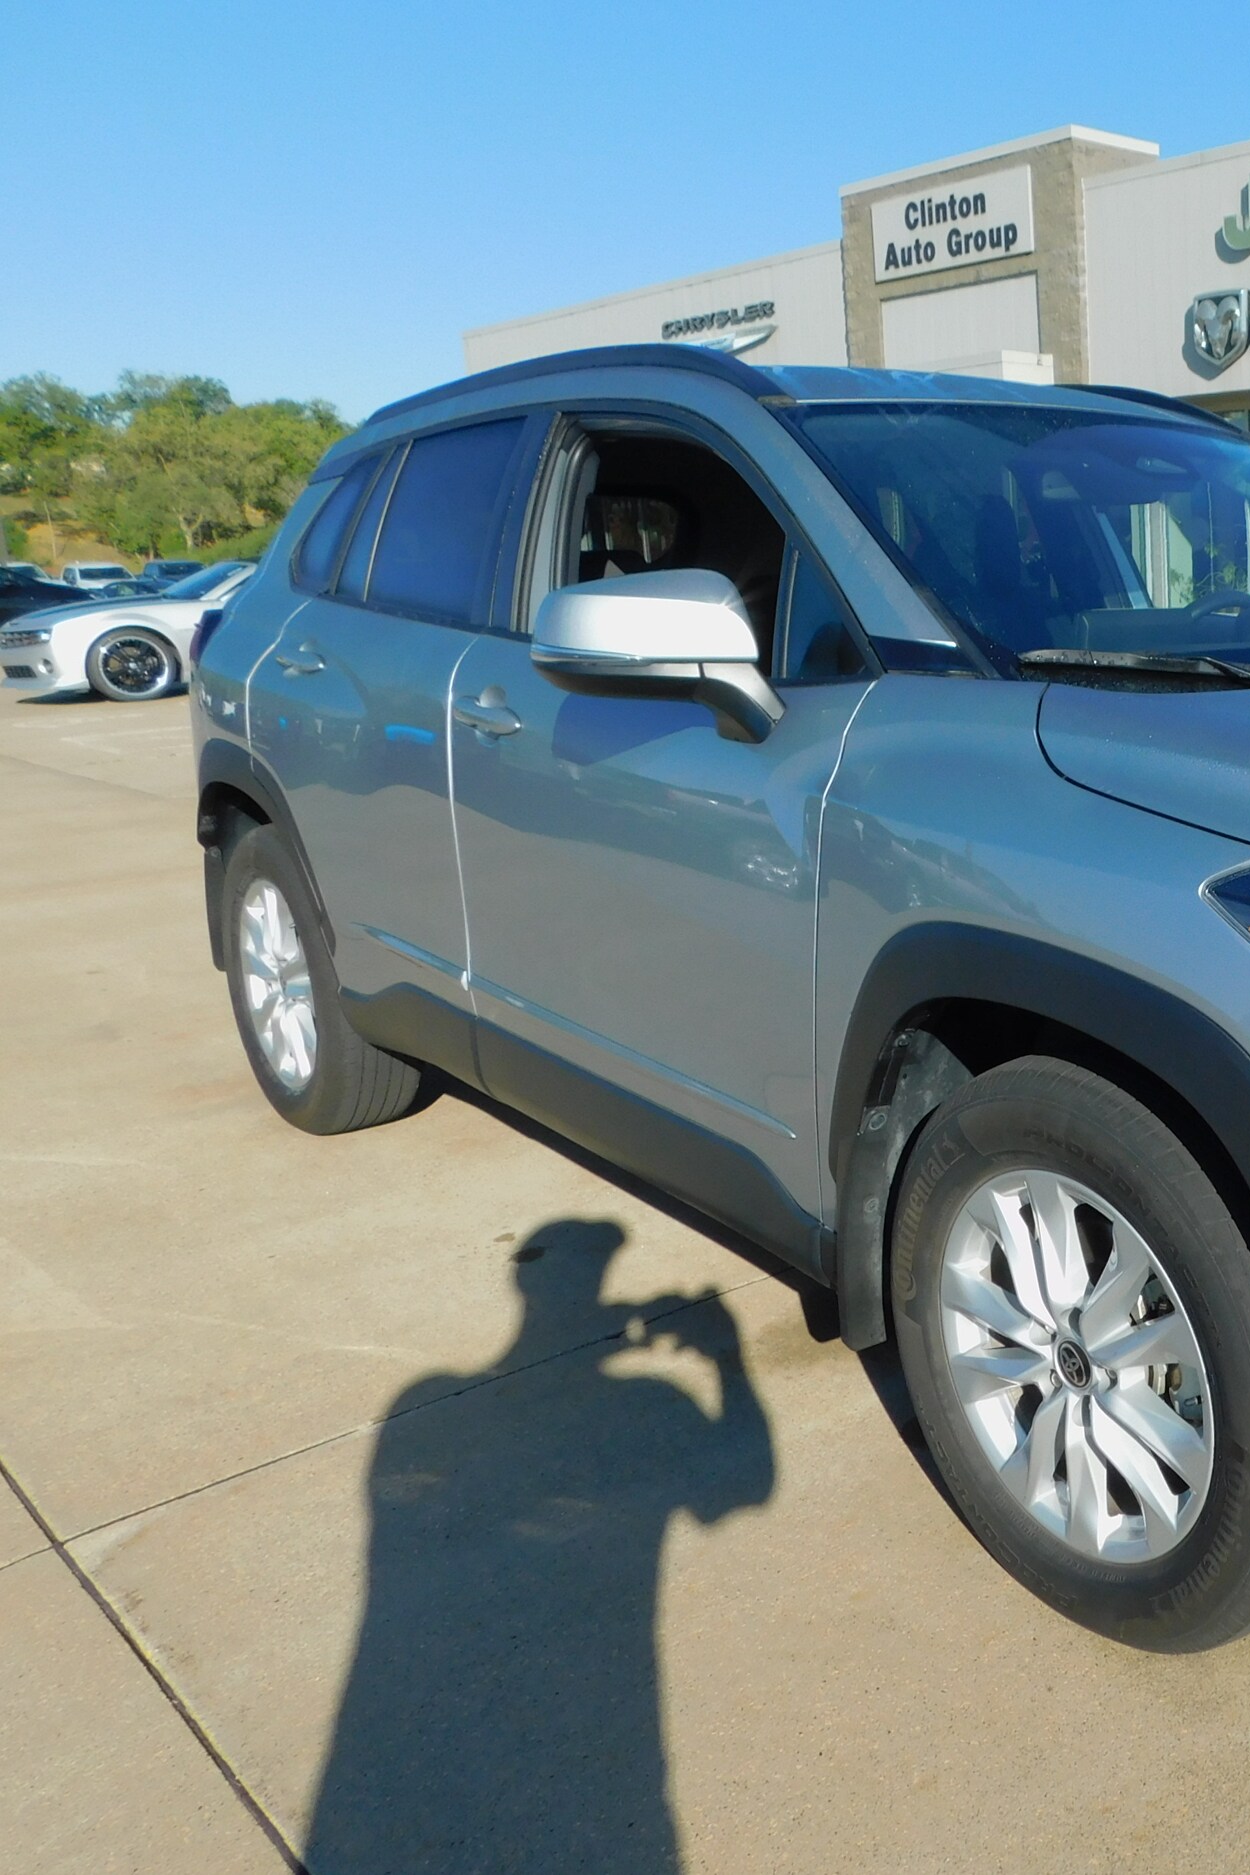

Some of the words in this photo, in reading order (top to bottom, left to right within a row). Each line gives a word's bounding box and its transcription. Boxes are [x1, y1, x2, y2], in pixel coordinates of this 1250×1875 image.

[903, 190, 988, 231] Clinton
[884, 236, 937, 272] Auto
[945, 222, 1019, 257] Group
[660, 300, 777, 341] CHRYSLER
[892, 1142, 952, 1303] Continental
